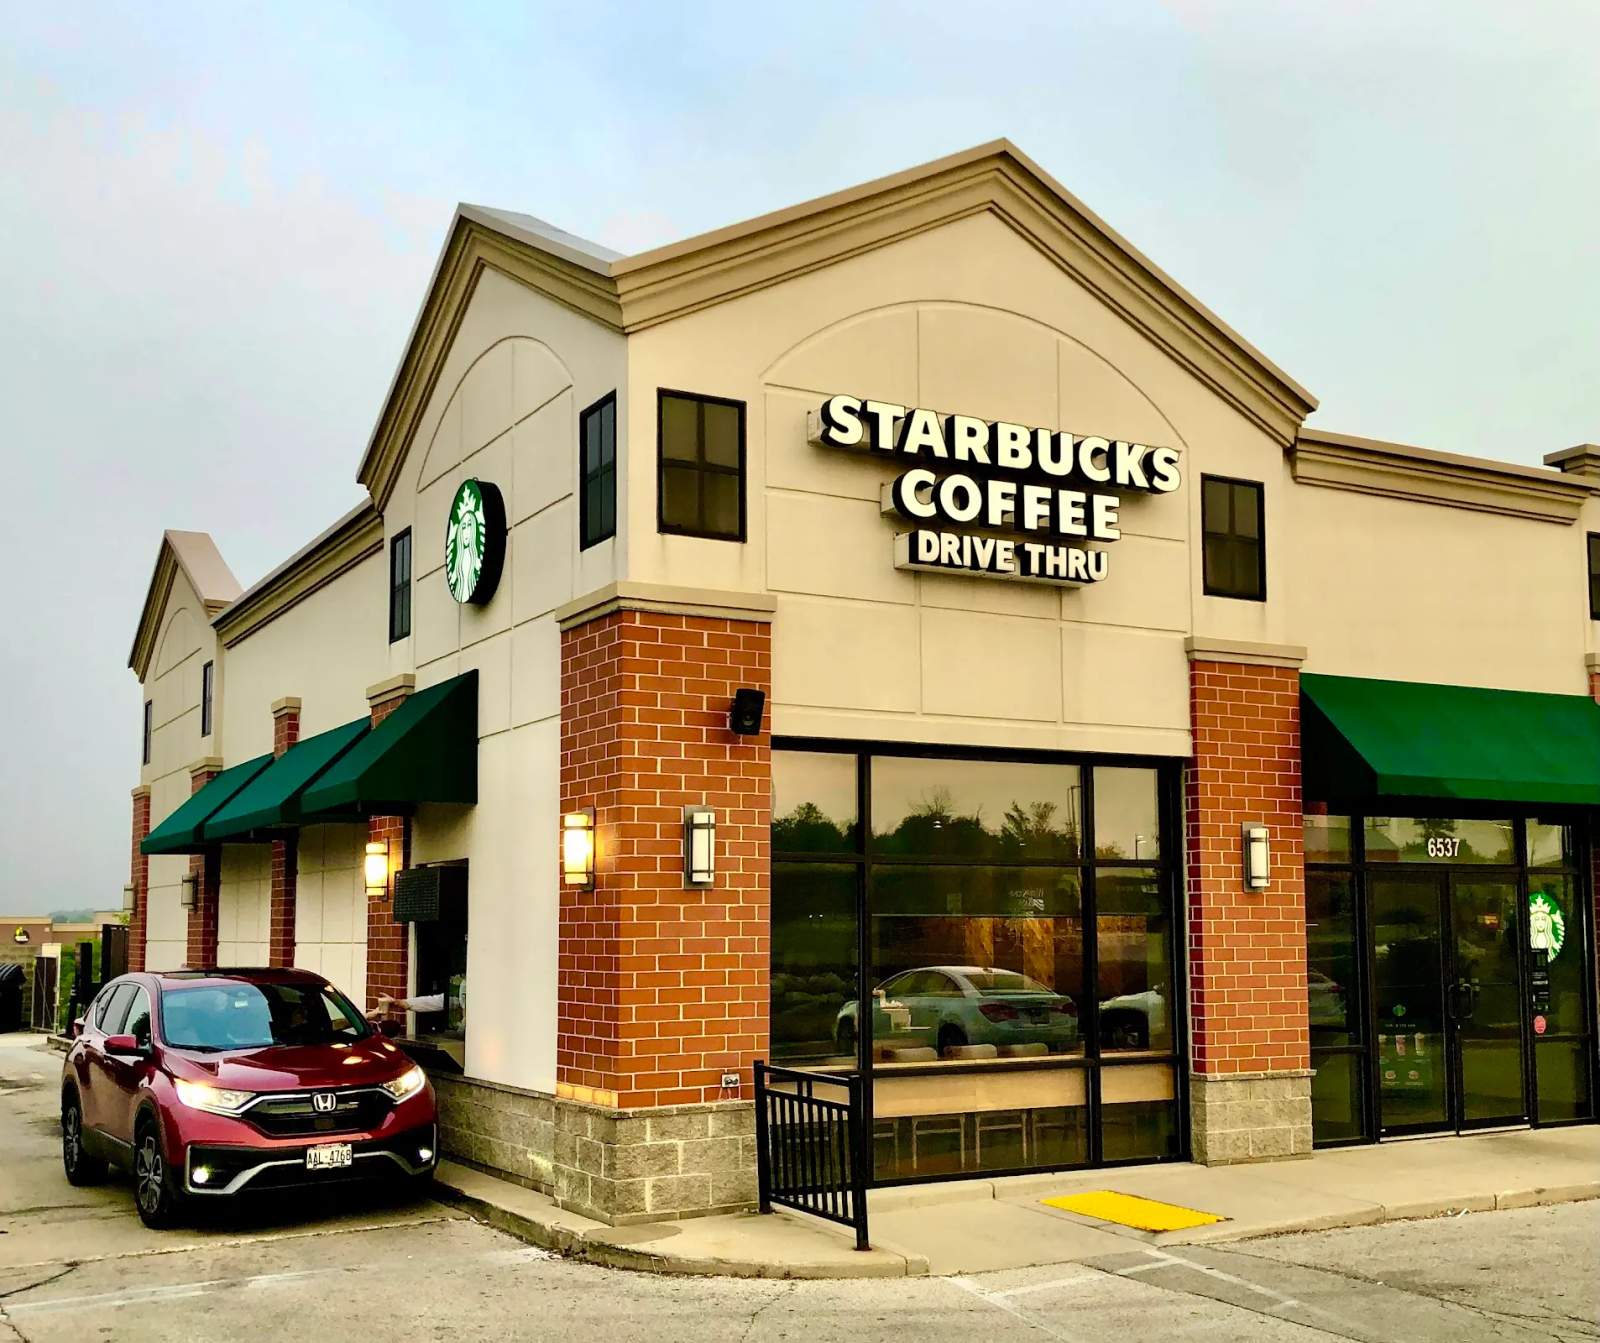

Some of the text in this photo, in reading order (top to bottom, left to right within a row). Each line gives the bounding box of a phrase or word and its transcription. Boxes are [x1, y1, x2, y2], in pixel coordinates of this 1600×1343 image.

[826, 394, 1182, 492] STARBUCKS
[899, 468, 1121, 541] COFFEE
[917, 529, 1109, 582] DRIVE THRU
[1427, 837, 1460, 858] 6537
